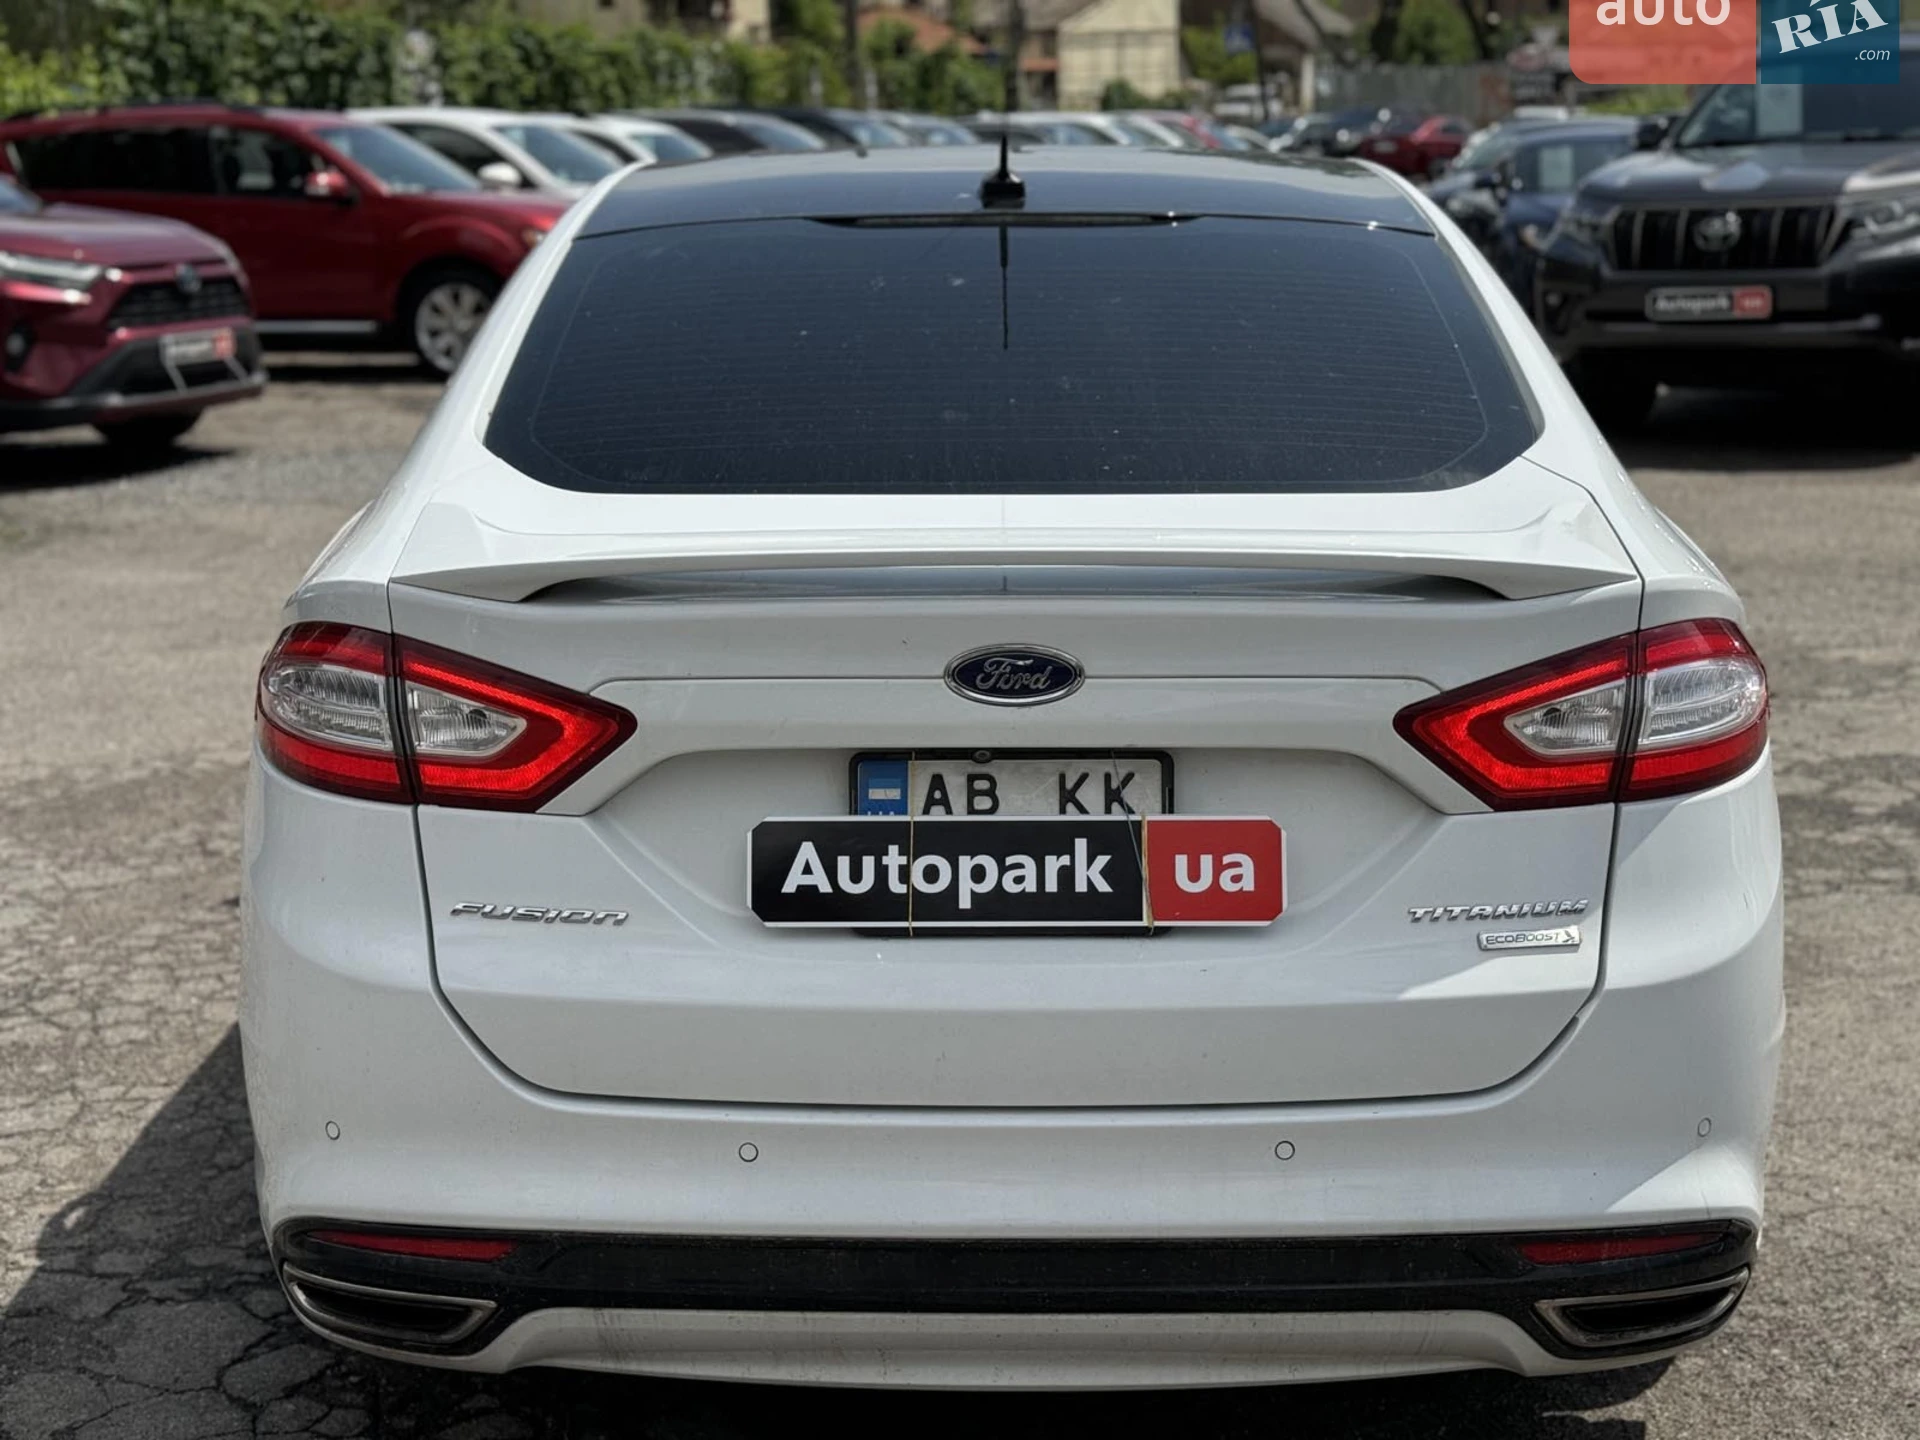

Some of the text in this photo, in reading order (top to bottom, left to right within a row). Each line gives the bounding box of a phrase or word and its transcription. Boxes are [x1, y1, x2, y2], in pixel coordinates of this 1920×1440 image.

[976, 657, 1053, 690] Ford
[921, 772, 1137, 815] AB KK
[781, 837, 1256, 910] Autopark ua
[450, 902, 629, 926] FUSION
[1408, 899, 1589, 923] TITANIUM
